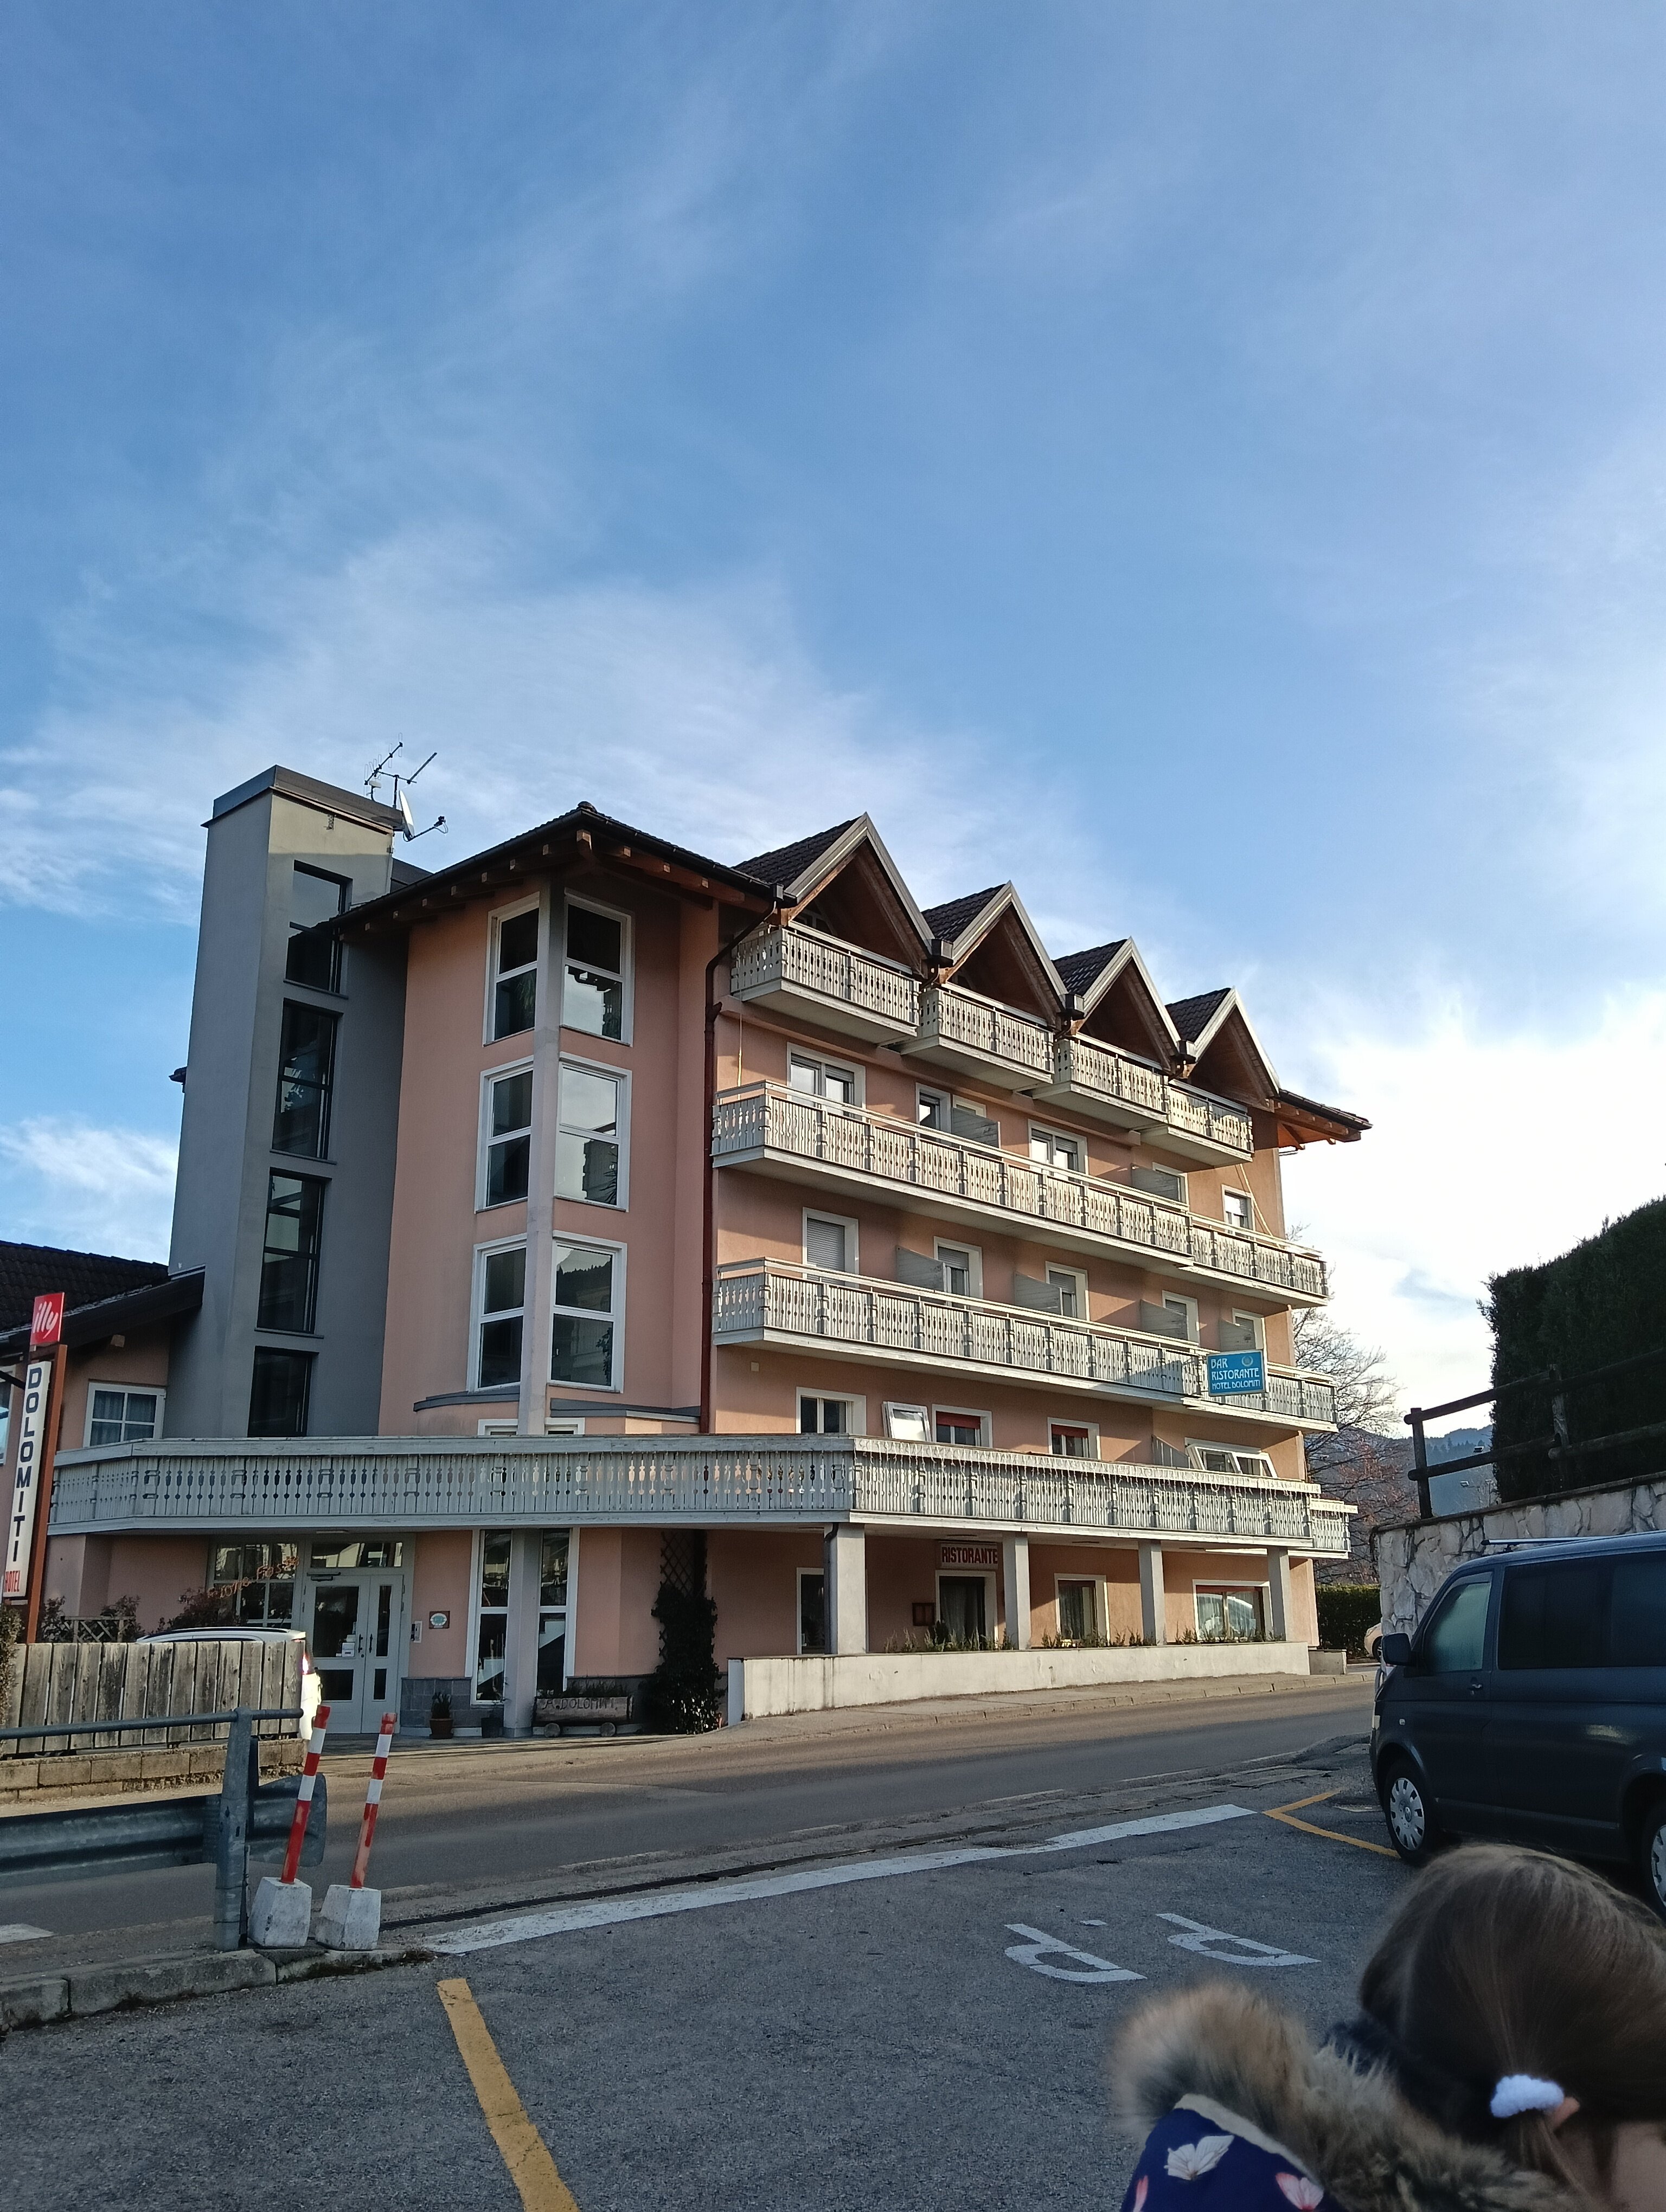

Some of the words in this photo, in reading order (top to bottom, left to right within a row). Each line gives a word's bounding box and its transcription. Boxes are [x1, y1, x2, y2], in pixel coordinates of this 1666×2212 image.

[33, 1301, 59, 1339] illy
[1211, 1358, 1228, 1369] BAR
[1212, 1368, 1260, 1381] RISTORANTE
[1212, 1381, 1231, 1390] HOTEL
[1232, 1379, 1260, 1388] DOLOMITI
[13, 1367, 42, 1562] DOLOMITI
[941, 1547, 998, 1564] RISTORANTE
[4, 1570, 21, 1593] HOTEL
